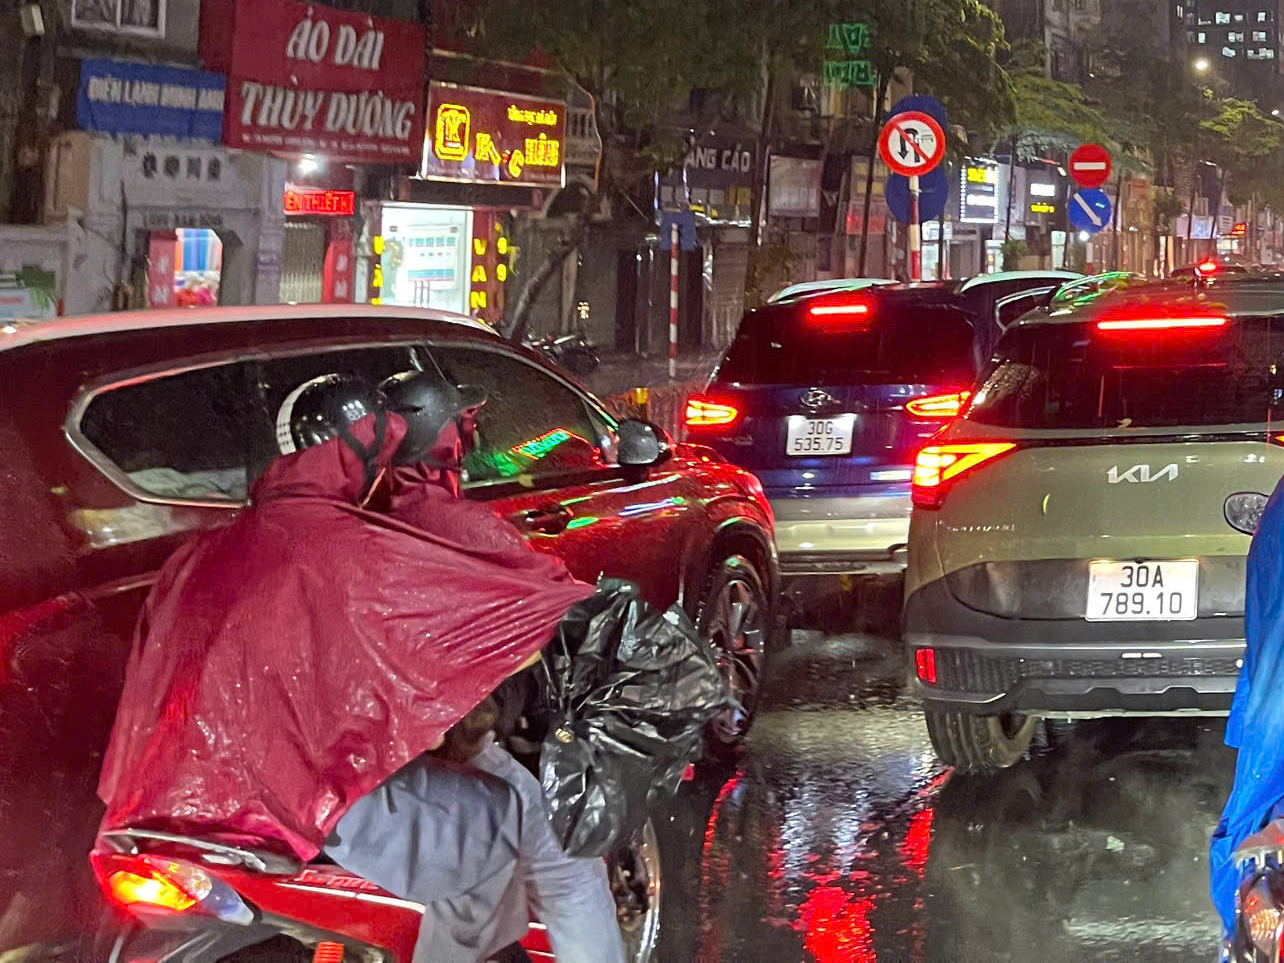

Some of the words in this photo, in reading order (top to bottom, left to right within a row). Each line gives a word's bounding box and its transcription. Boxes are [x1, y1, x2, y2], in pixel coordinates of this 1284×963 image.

[287, 6, 330, 63] ÁO
[334, 16, 384, 70] DÀI
[241, 74, 324, 130] THÙY
[326, 90, 415, 141] DƯƠNG
[721, 143, 751, 172] CÁO
[808, 421, 833, 435] 30G
[794, 437, 844, 451] 535.75
[1106, 463, 1179, 484] KIA
[1120, 565, 1164, 588] 30A
[1100, 592, 1182, 616] 789.10
